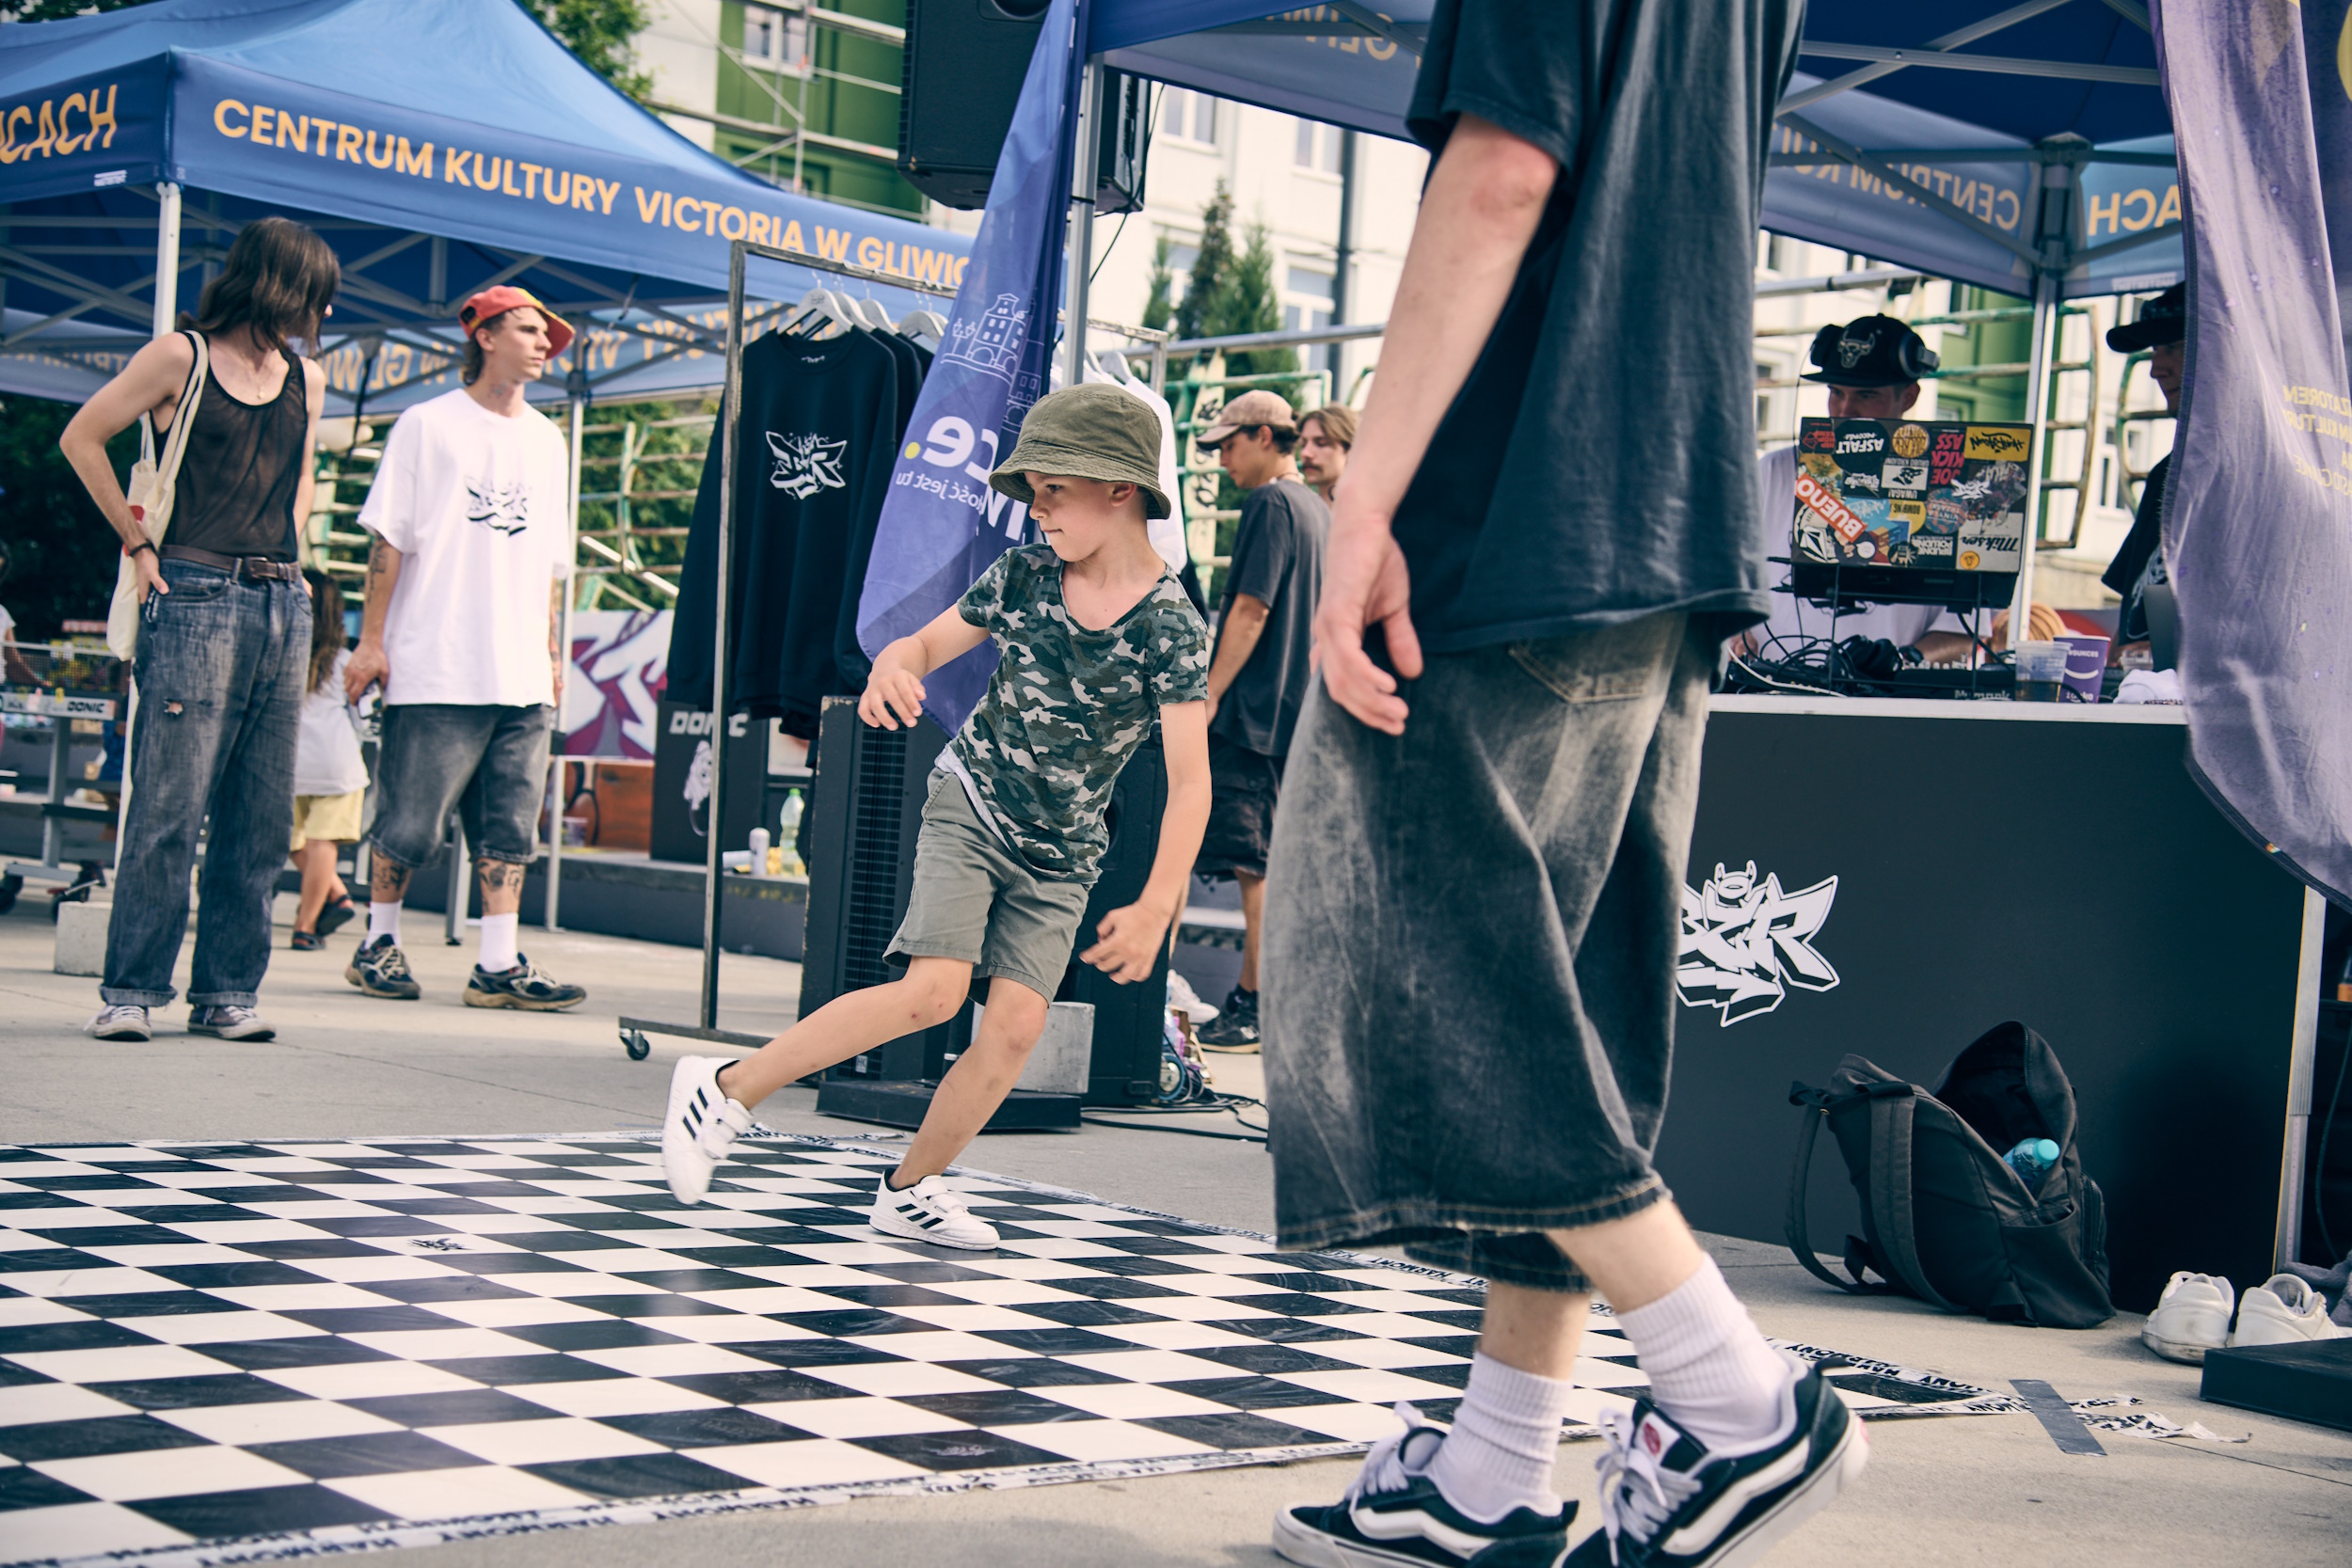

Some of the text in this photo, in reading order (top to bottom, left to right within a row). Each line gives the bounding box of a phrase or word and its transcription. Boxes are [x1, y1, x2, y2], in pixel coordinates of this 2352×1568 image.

[213, 98, 435, 180] CENTRUM
[443, 146, 622, 215] KULTURY
[634, 185, 806, 255] VICTORIA
[815, 225, 852, 261] W
[1836, 438, 1883, 455] ASFALT
[1934, 433, 1964, 451] ASS
[1930, 451, 1964, 467] KICK
[1931, 468, 1961, 485] JOE
[1887, 488, 1918, 499] UWAGA!
[1959, 536, 2018, 552] Mikser
[67, 701, 105, 713] DONIC
[669, 710, 749, 738] DOC
